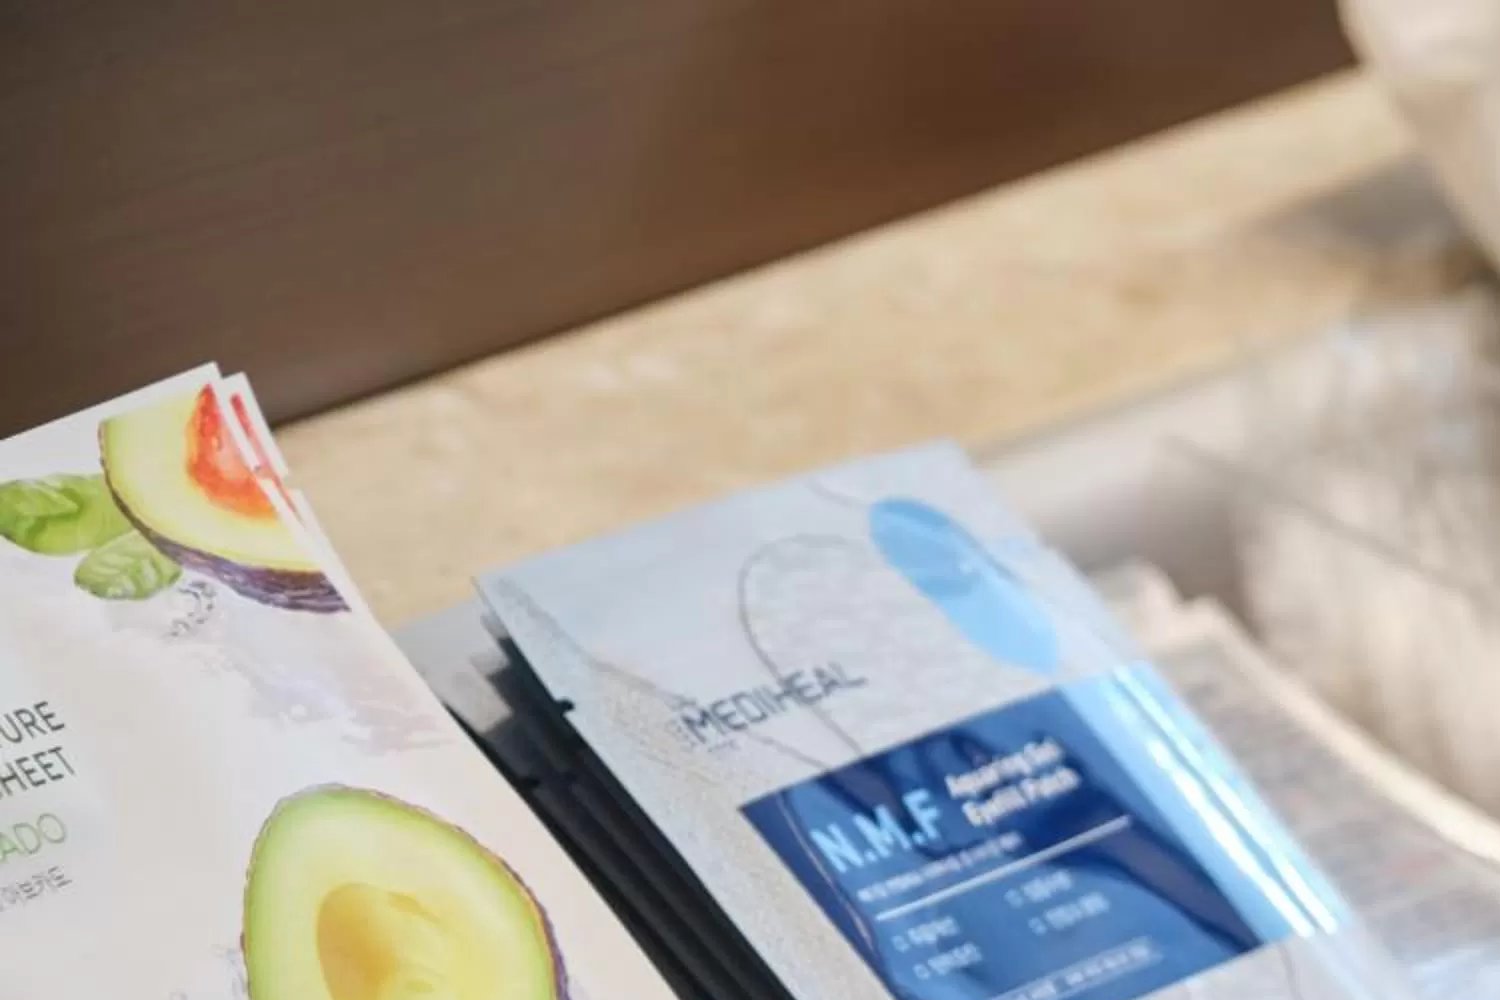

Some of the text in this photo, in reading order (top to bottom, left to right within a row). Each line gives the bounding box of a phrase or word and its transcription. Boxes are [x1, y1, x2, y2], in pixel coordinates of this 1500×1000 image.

[0, 701, 65, 747] URE
[681, 661, 868, 744] MEDIHEAL
[0, 746, 75, 800] HEET
[810, 788, 942, 873] N.M.F
